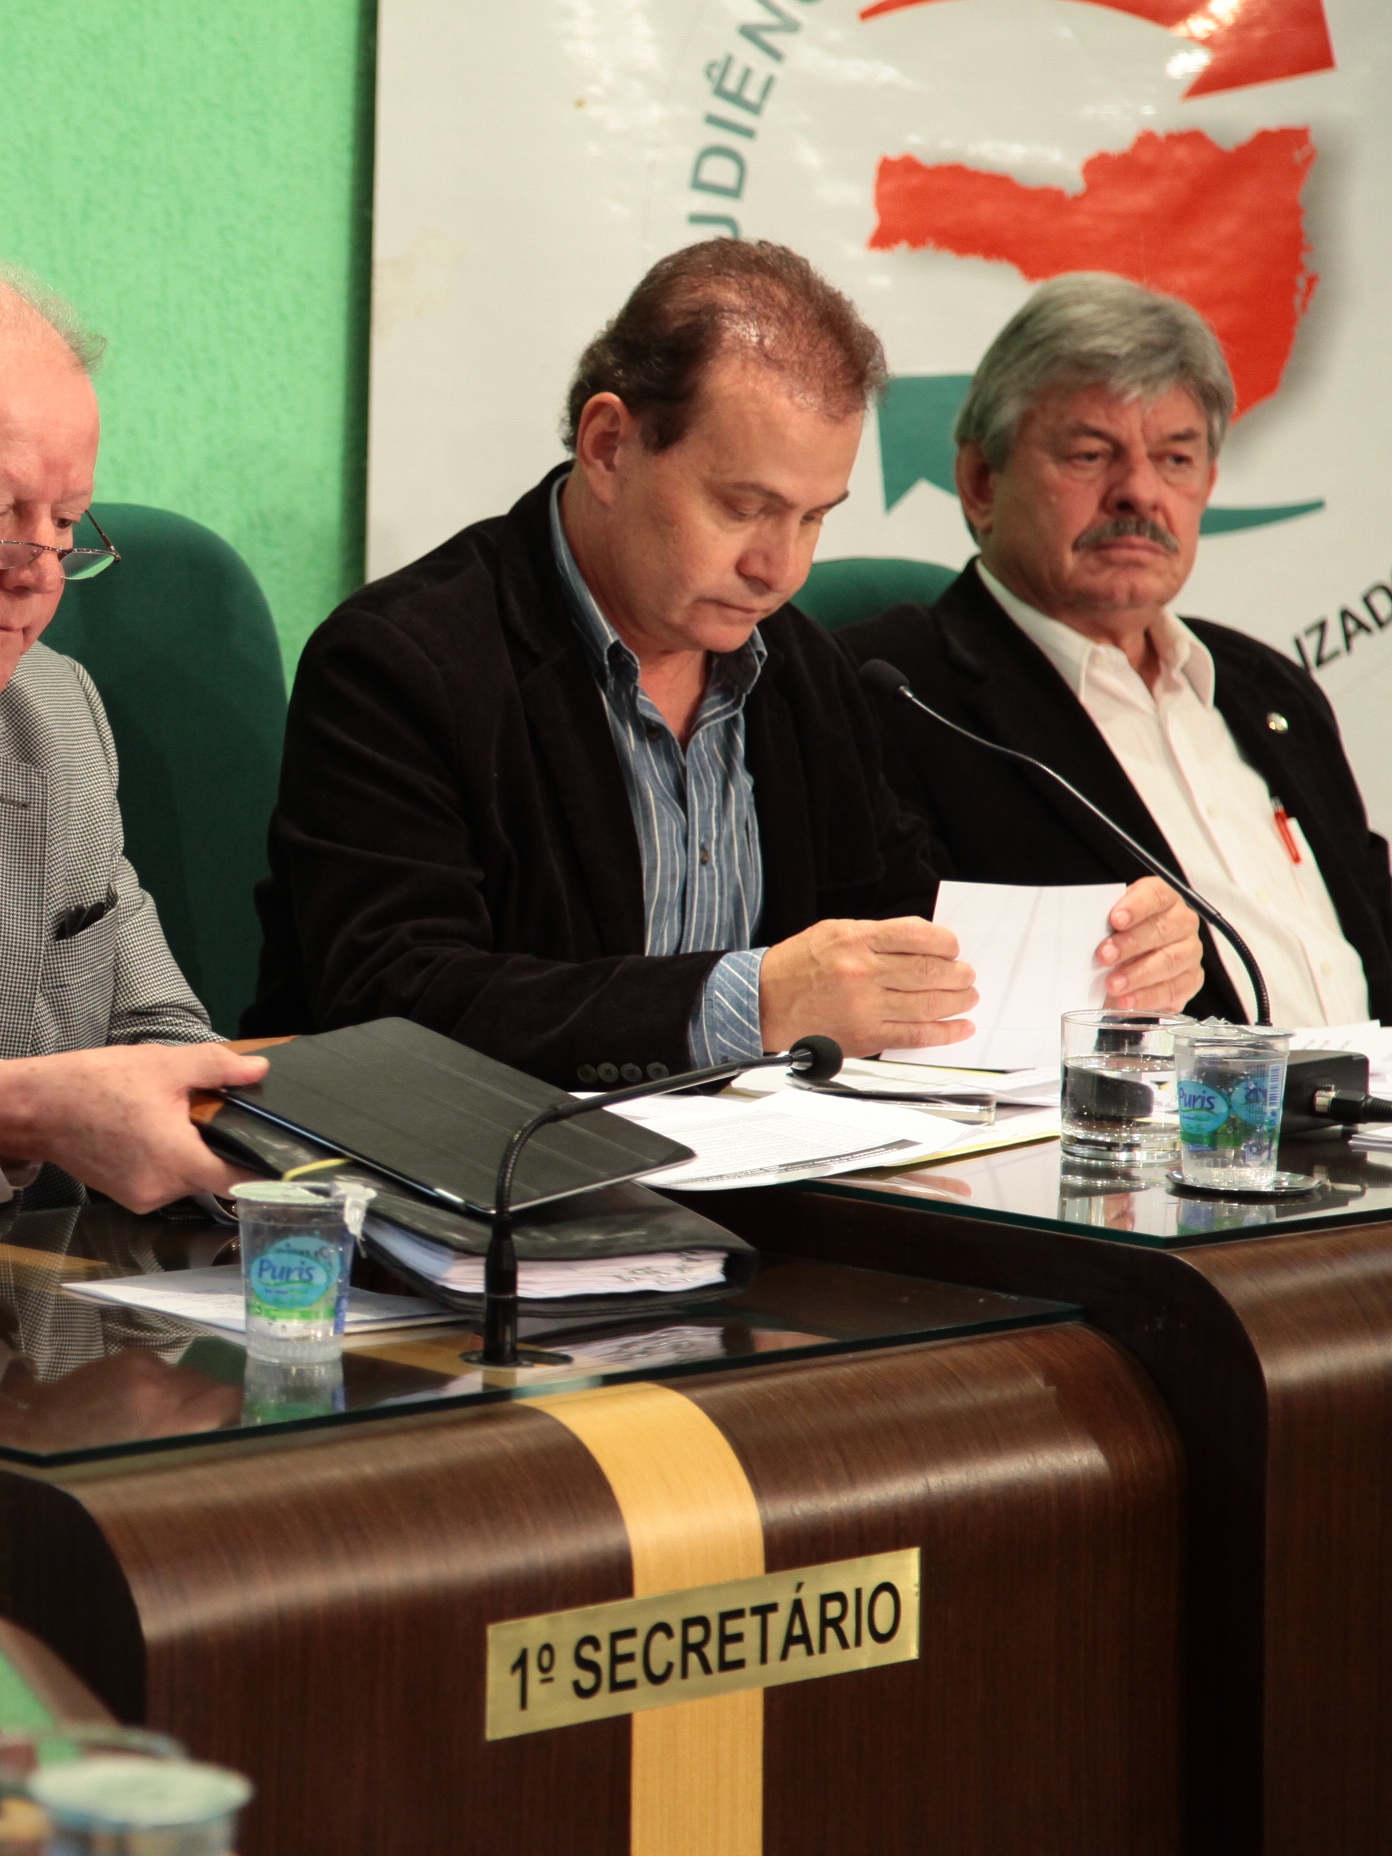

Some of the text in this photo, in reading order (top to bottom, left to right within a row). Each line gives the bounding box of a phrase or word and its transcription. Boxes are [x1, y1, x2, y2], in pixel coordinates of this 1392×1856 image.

[687, 0, 825, 239] UDIÊN
[1178, 1087, 1216, 1111] Puris
[258, 1258, 315, 1283] Puris
[571, 1581, 902, 1699] SECRETÁRIO
